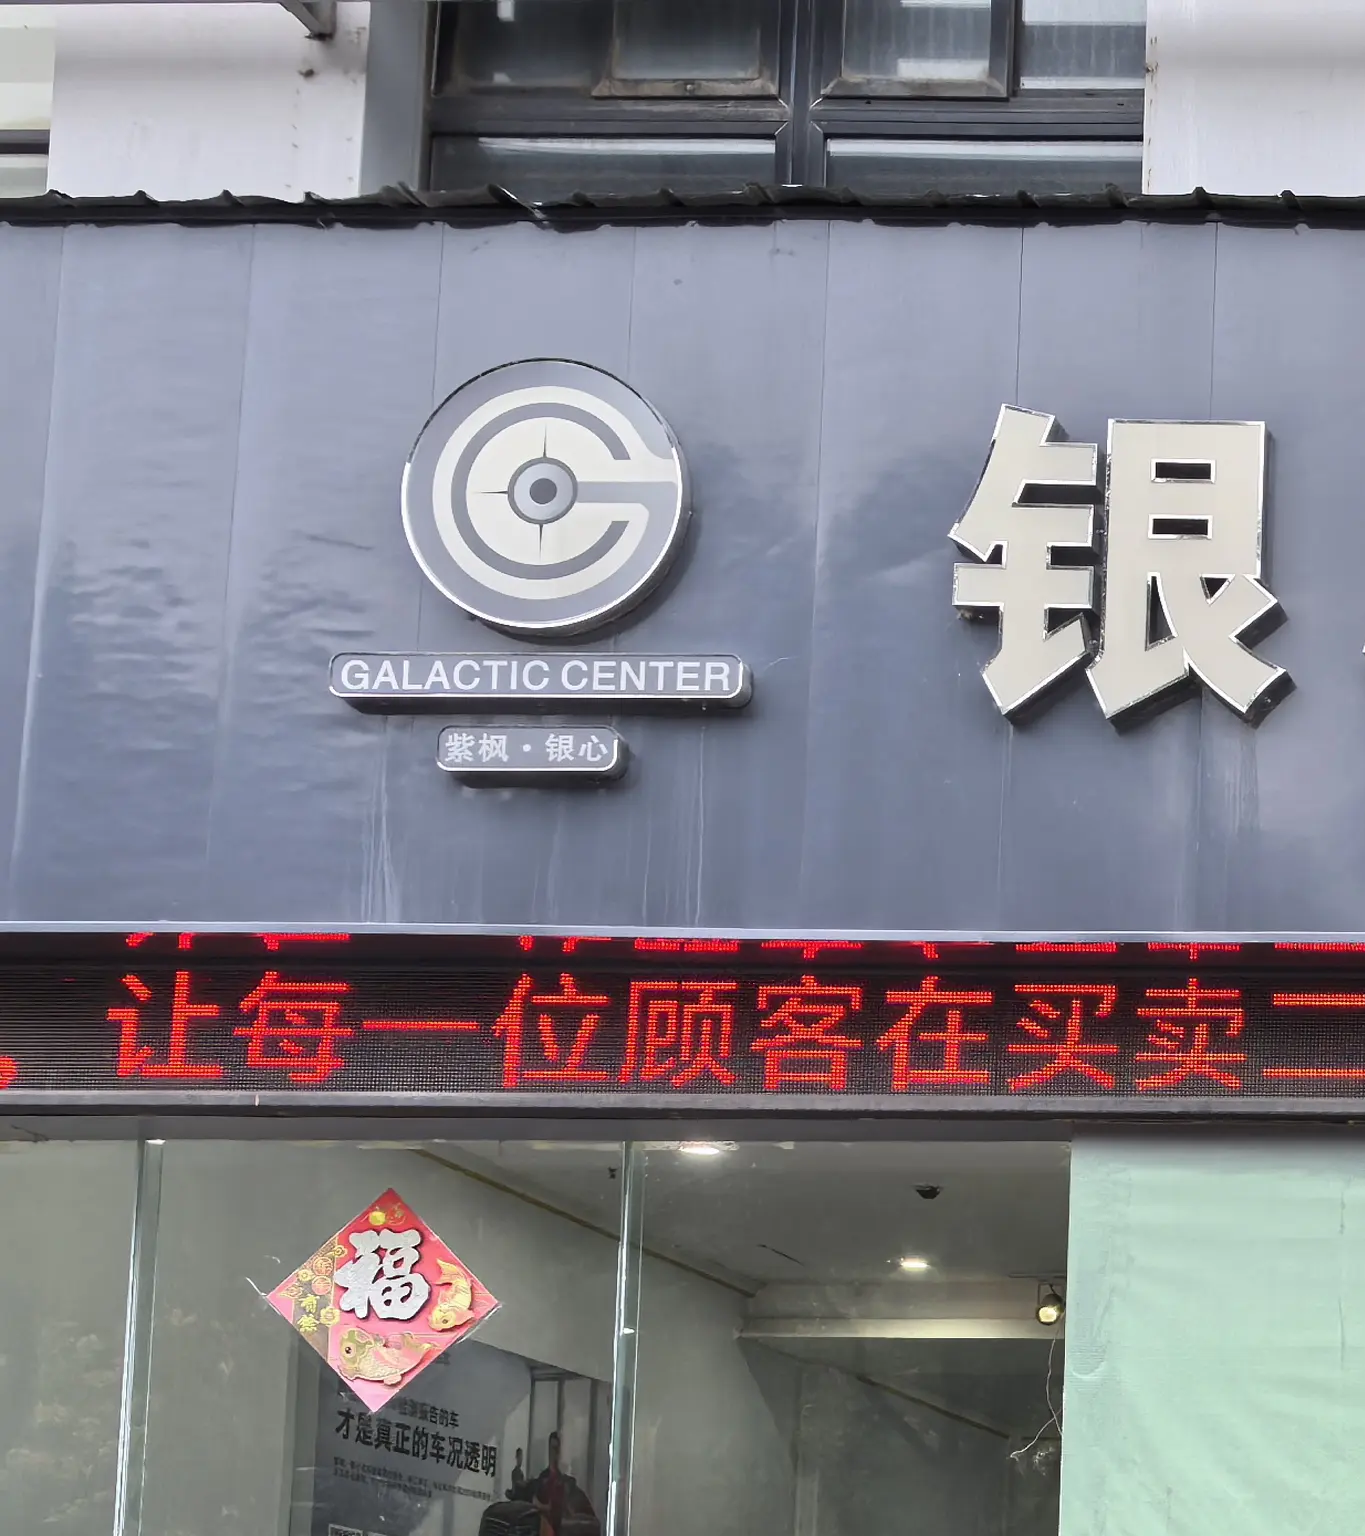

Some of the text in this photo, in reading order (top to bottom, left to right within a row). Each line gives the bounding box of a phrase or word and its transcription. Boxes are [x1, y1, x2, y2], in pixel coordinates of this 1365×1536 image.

[341, 659, 731, 691] GALACTIC CENTER
[333, 1228, 431, 1320] 福
